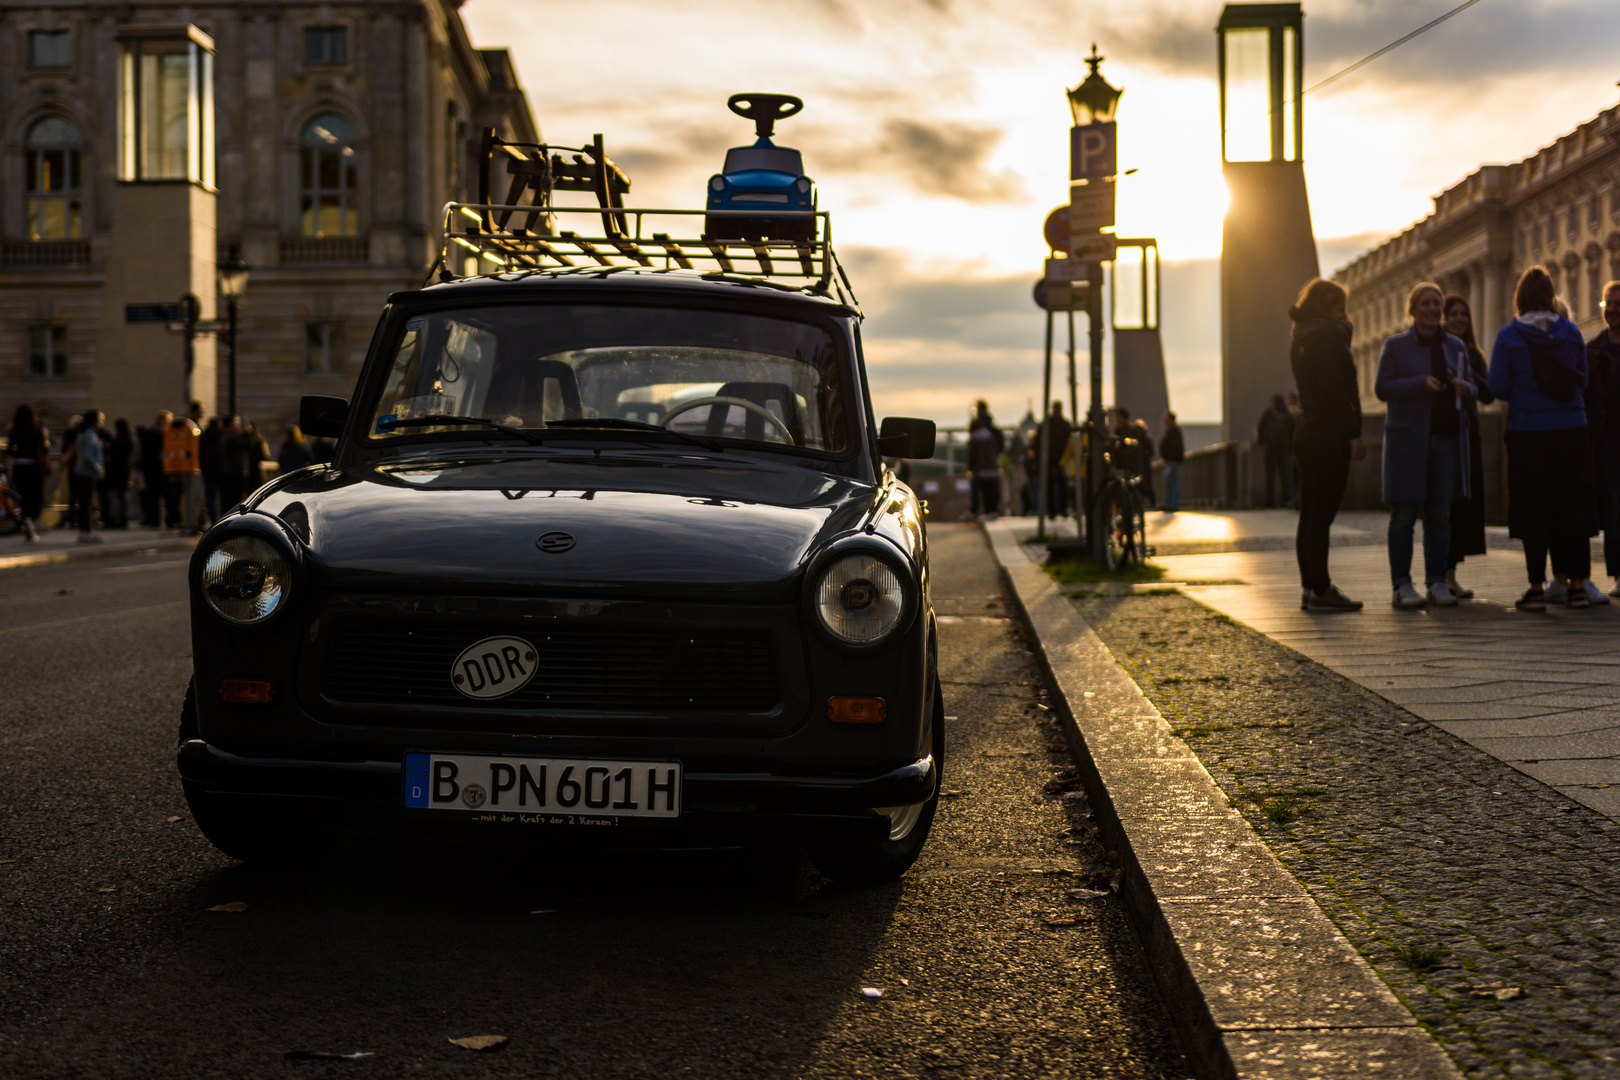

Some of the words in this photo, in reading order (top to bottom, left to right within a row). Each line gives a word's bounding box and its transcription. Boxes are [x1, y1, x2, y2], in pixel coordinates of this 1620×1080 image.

[1080, 130, 1107, 173] P
[462, 645, 527, 692] DDR
[412, 786, 421, 798] D
[432, 760, 460, 803] B
[501, 814, 515, 822] der
[519, 814, 546, 824] Kraft
[549, 816, 564, 825] der
[568, 815, 575, 825] 2
[579, 816, 612, 827] Kerzen
